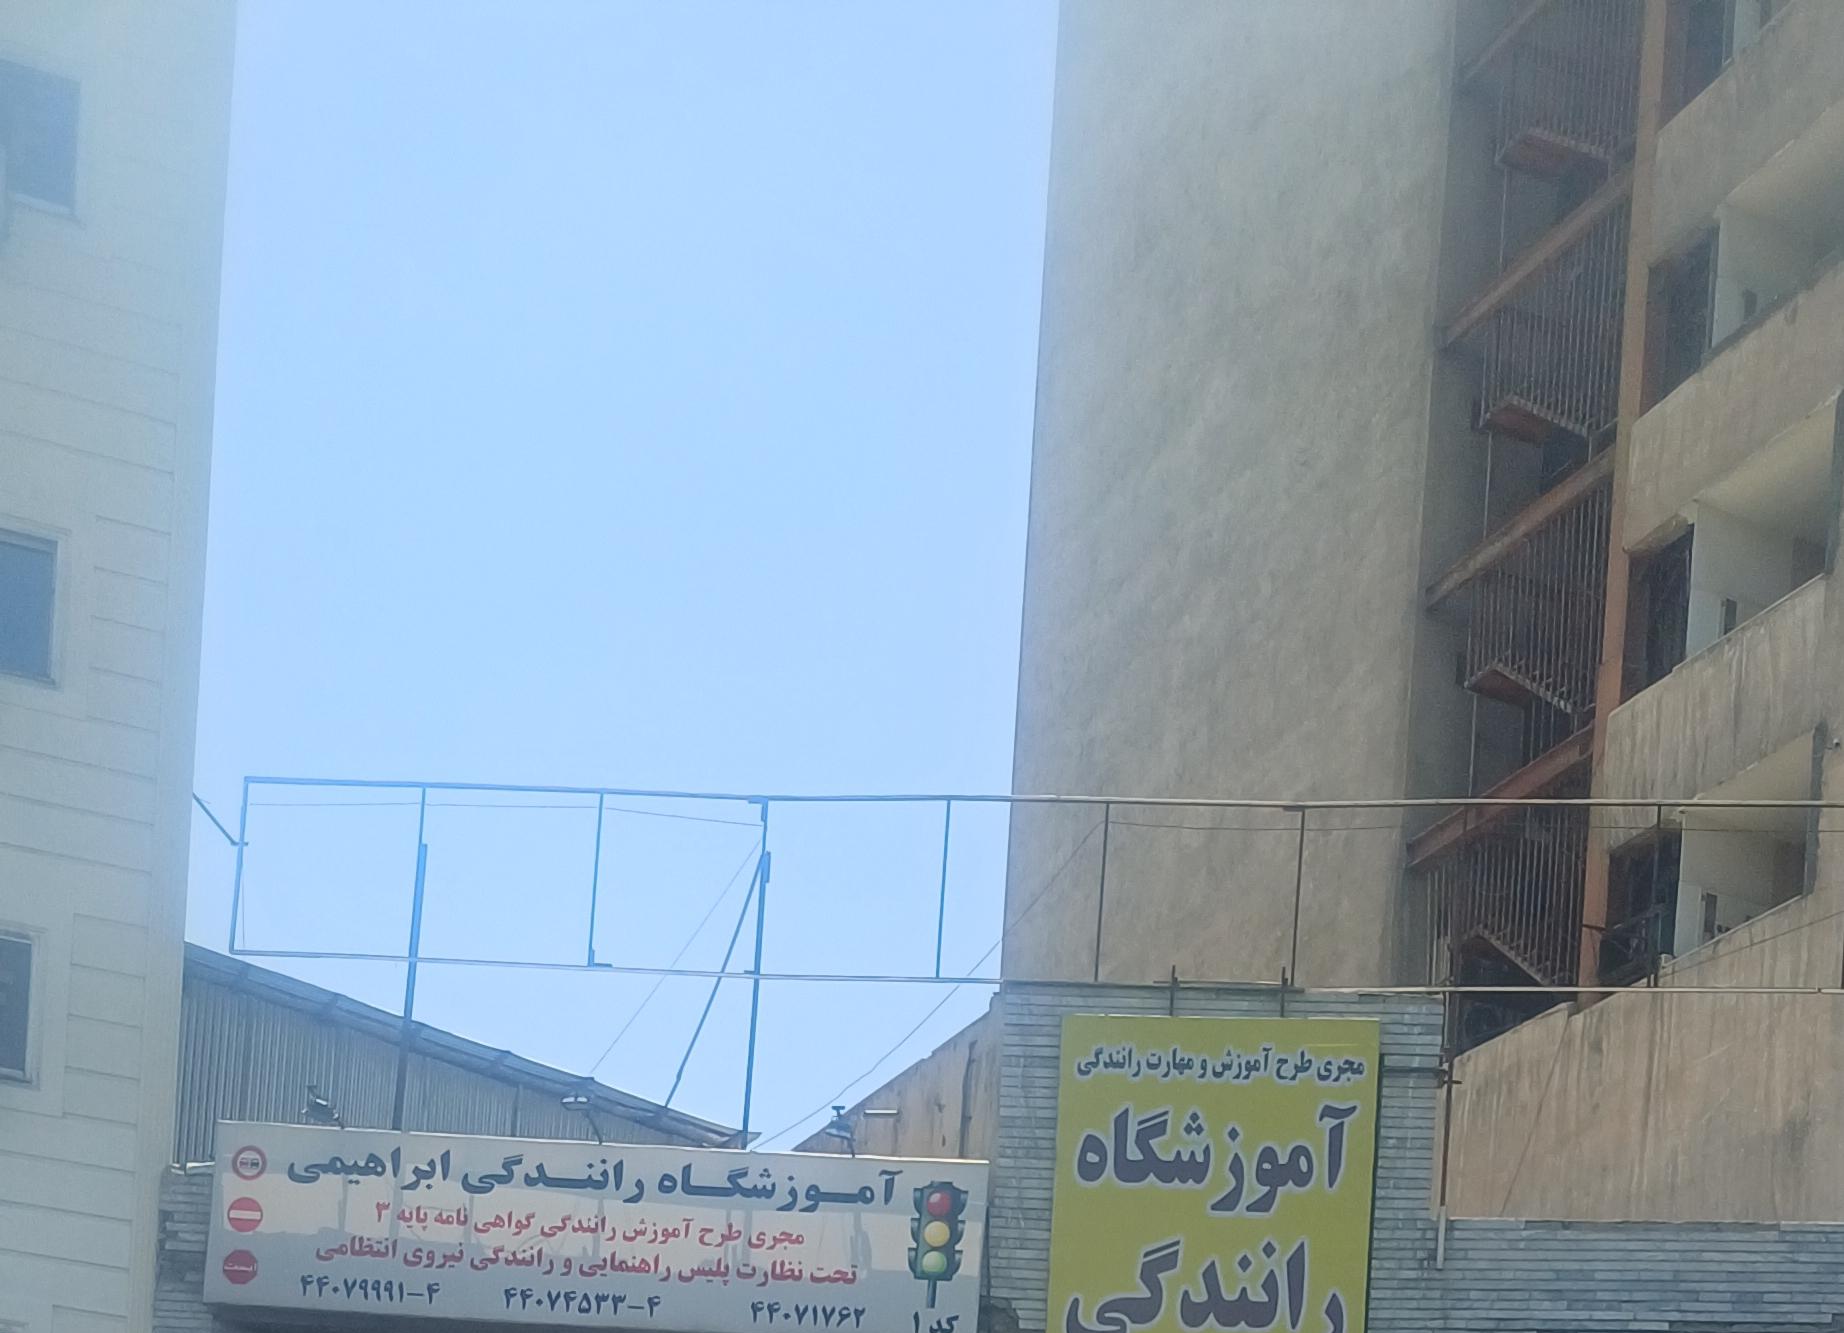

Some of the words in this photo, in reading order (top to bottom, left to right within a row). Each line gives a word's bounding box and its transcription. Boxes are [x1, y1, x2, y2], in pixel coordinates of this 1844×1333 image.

[1077, 1047, 1142, 1078] رانندگی
[1146, 1048, 1194, 1078] مهارت
[1199, 1057, 1208, 1078] و
[1212, 1047, 1272, 1080] آموزش
[1275, 1050, 1312, 1080] طرح
[1317, 1057, 1365, 1082] مجری
[287, 1146, 451, 1191] ابراهیمی
[1077, 1104, 1358, 1213] آموزشگاه
[461, 1153, 645, 1204] رانندگی
[657, 1163, 903, 1213] آموزشگاه
[396, 1205, 428, 1232] پایه
[434, 1204, 468, 1227] نامه
[474, 1210, 536, 1235] گواهی
[539, 1212, 617, 1242] رانندگی
[622, 1217, 694, 1245] آموزش
[699, 1222, 742, 1246] طرح
[747, 1230, 805, 1250] مجری
[315, 1235, 398, 1263] انتظامی
[402, 1242, 465, 1269] نیروی
[469, 1246, 554, 1276] رانندگی
[560, 1259, 573, 1277] و
[578, 1251, 671, 1283] راهنمایی
[678, 1256, 729, 1287] پلیس
[736, 1257, 804, 1287] نظارت
[809, 1264, 857, 1285] تحت
